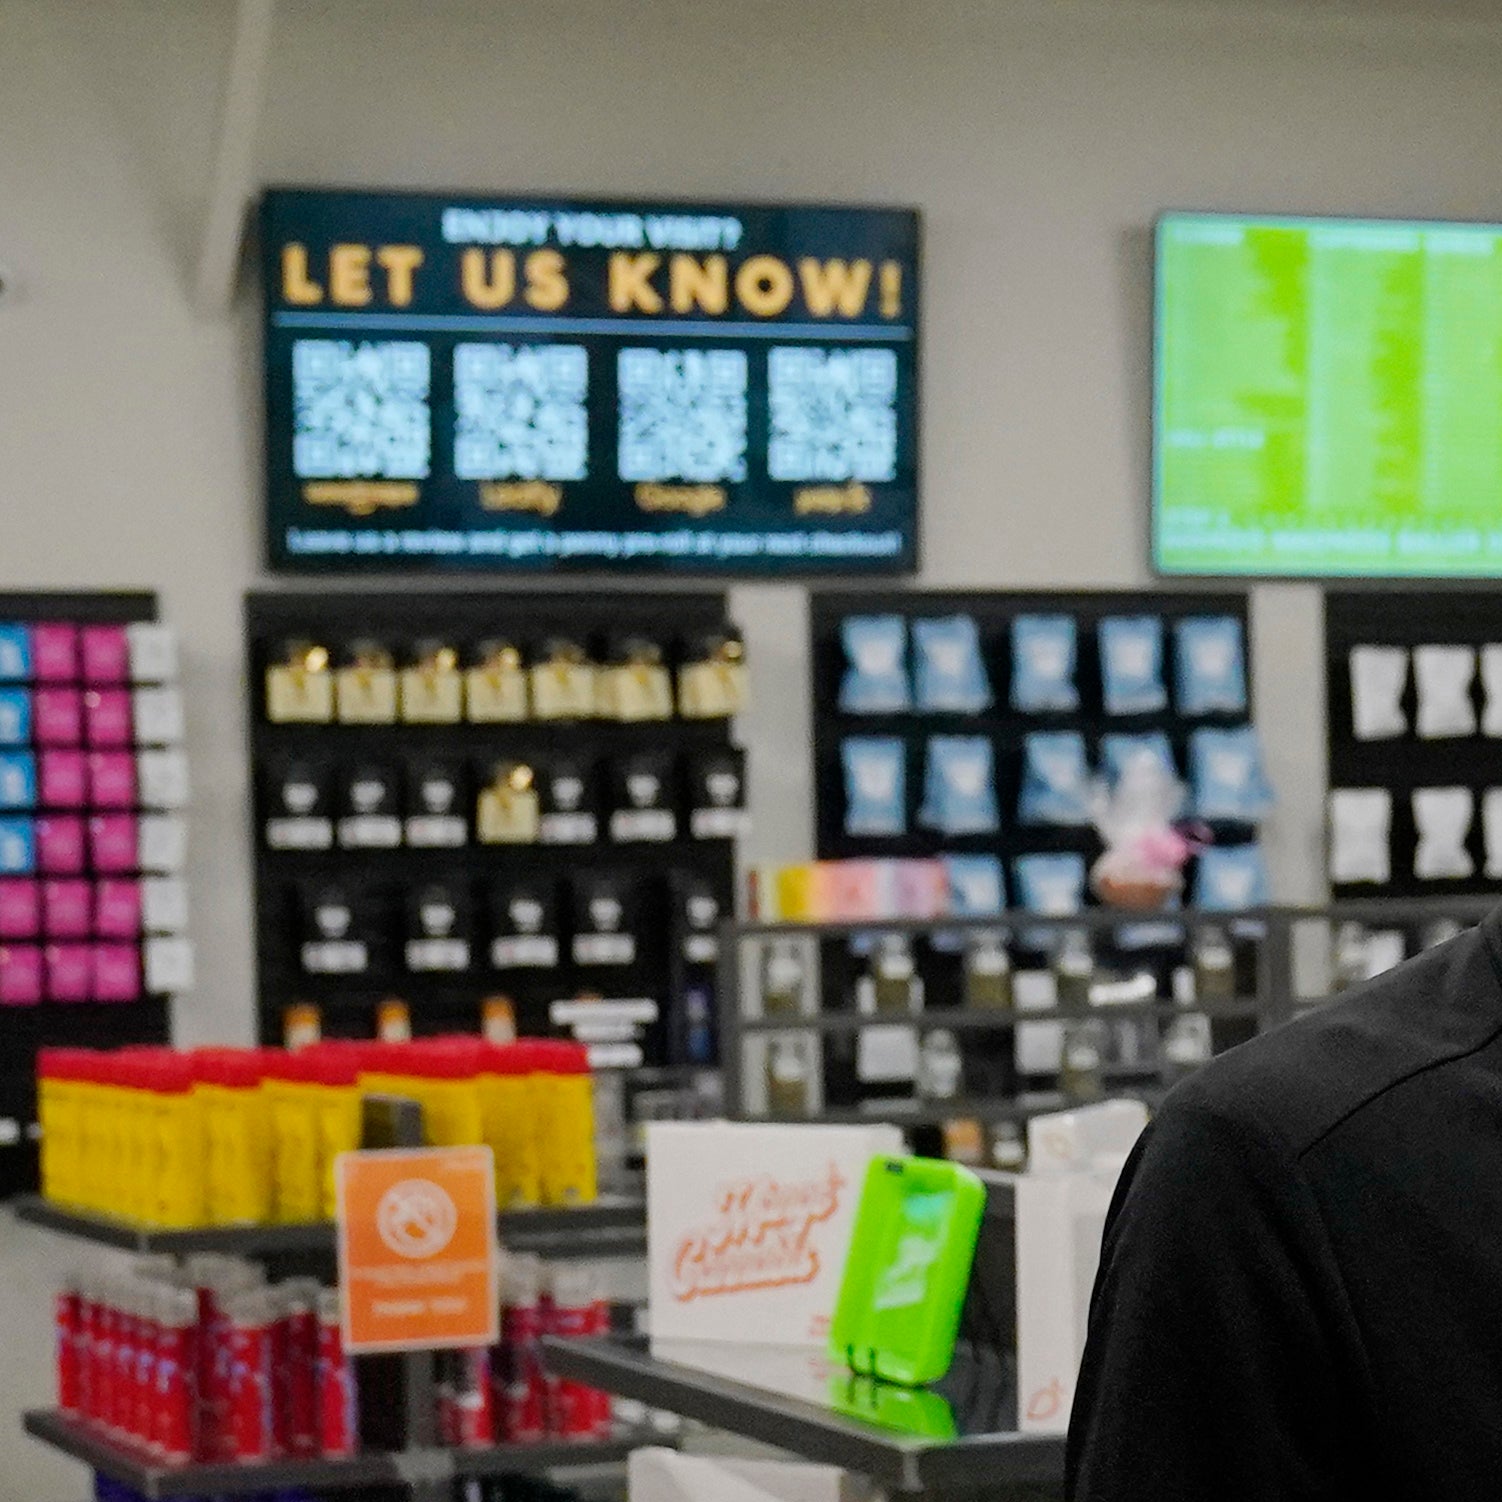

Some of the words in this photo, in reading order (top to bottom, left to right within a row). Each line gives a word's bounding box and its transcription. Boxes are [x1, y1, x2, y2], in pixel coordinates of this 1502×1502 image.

[281, 242, 423, 307] LET
[460, 248, 571, 312] US
[606, 251, 900, 319] KNOW!
